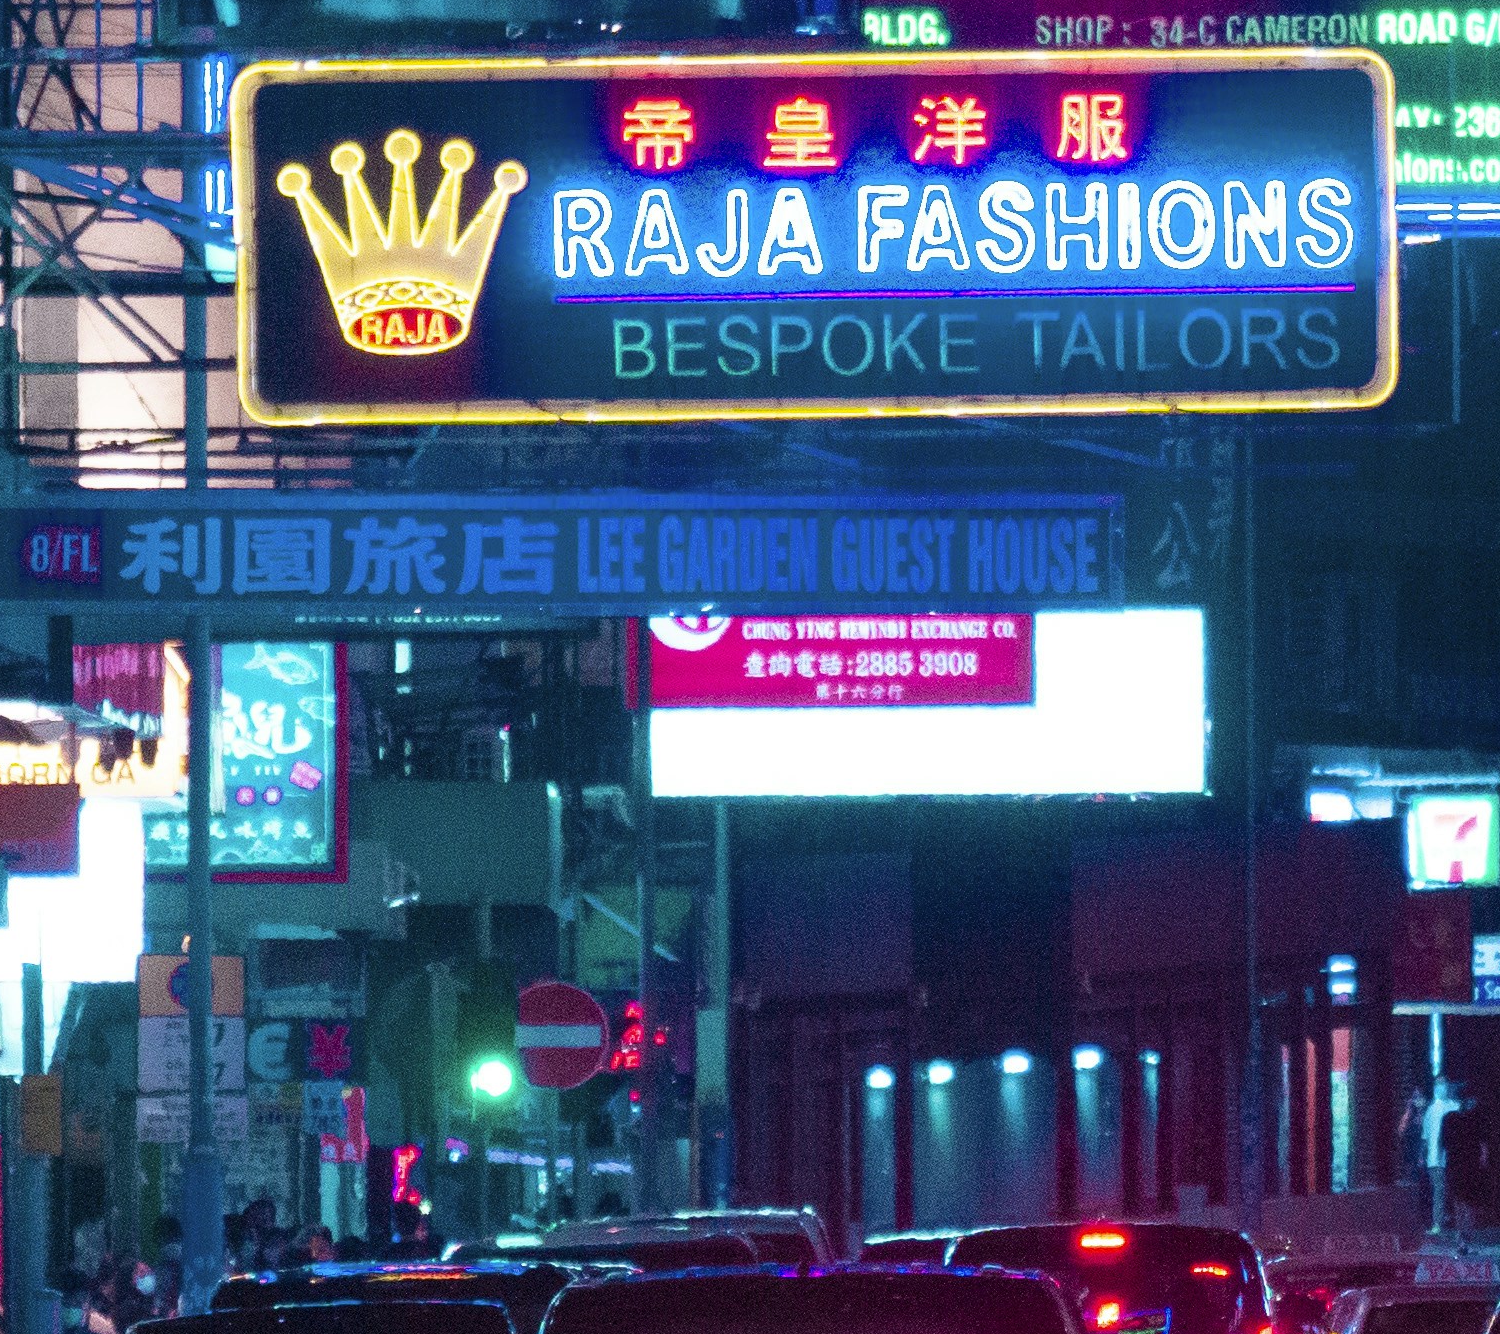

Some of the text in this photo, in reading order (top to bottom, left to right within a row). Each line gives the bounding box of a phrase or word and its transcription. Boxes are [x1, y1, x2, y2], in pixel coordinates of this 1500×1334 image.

[1225, 13, 1368, 45] CAMERON
[1376, 12, 1456, 46] ROAD
[622, 95, 1130, 167] 帝皇洋服
[553, 175, 1356, 280] RAJA FASHIONS
[360, 310, 450, 348] RAJA
[614, 307, 1342, 379] BESPOKE TAILORS
[118, 517, 560, 597] 利園旅店
[576, 520, 1098, 595] LEE GARDEN GUEST HOUSE
[741, 620, 792, 640] CHUNG
[796, 620, 836, 640] YING
[911, 621, 988, 640] EXCHANGE
